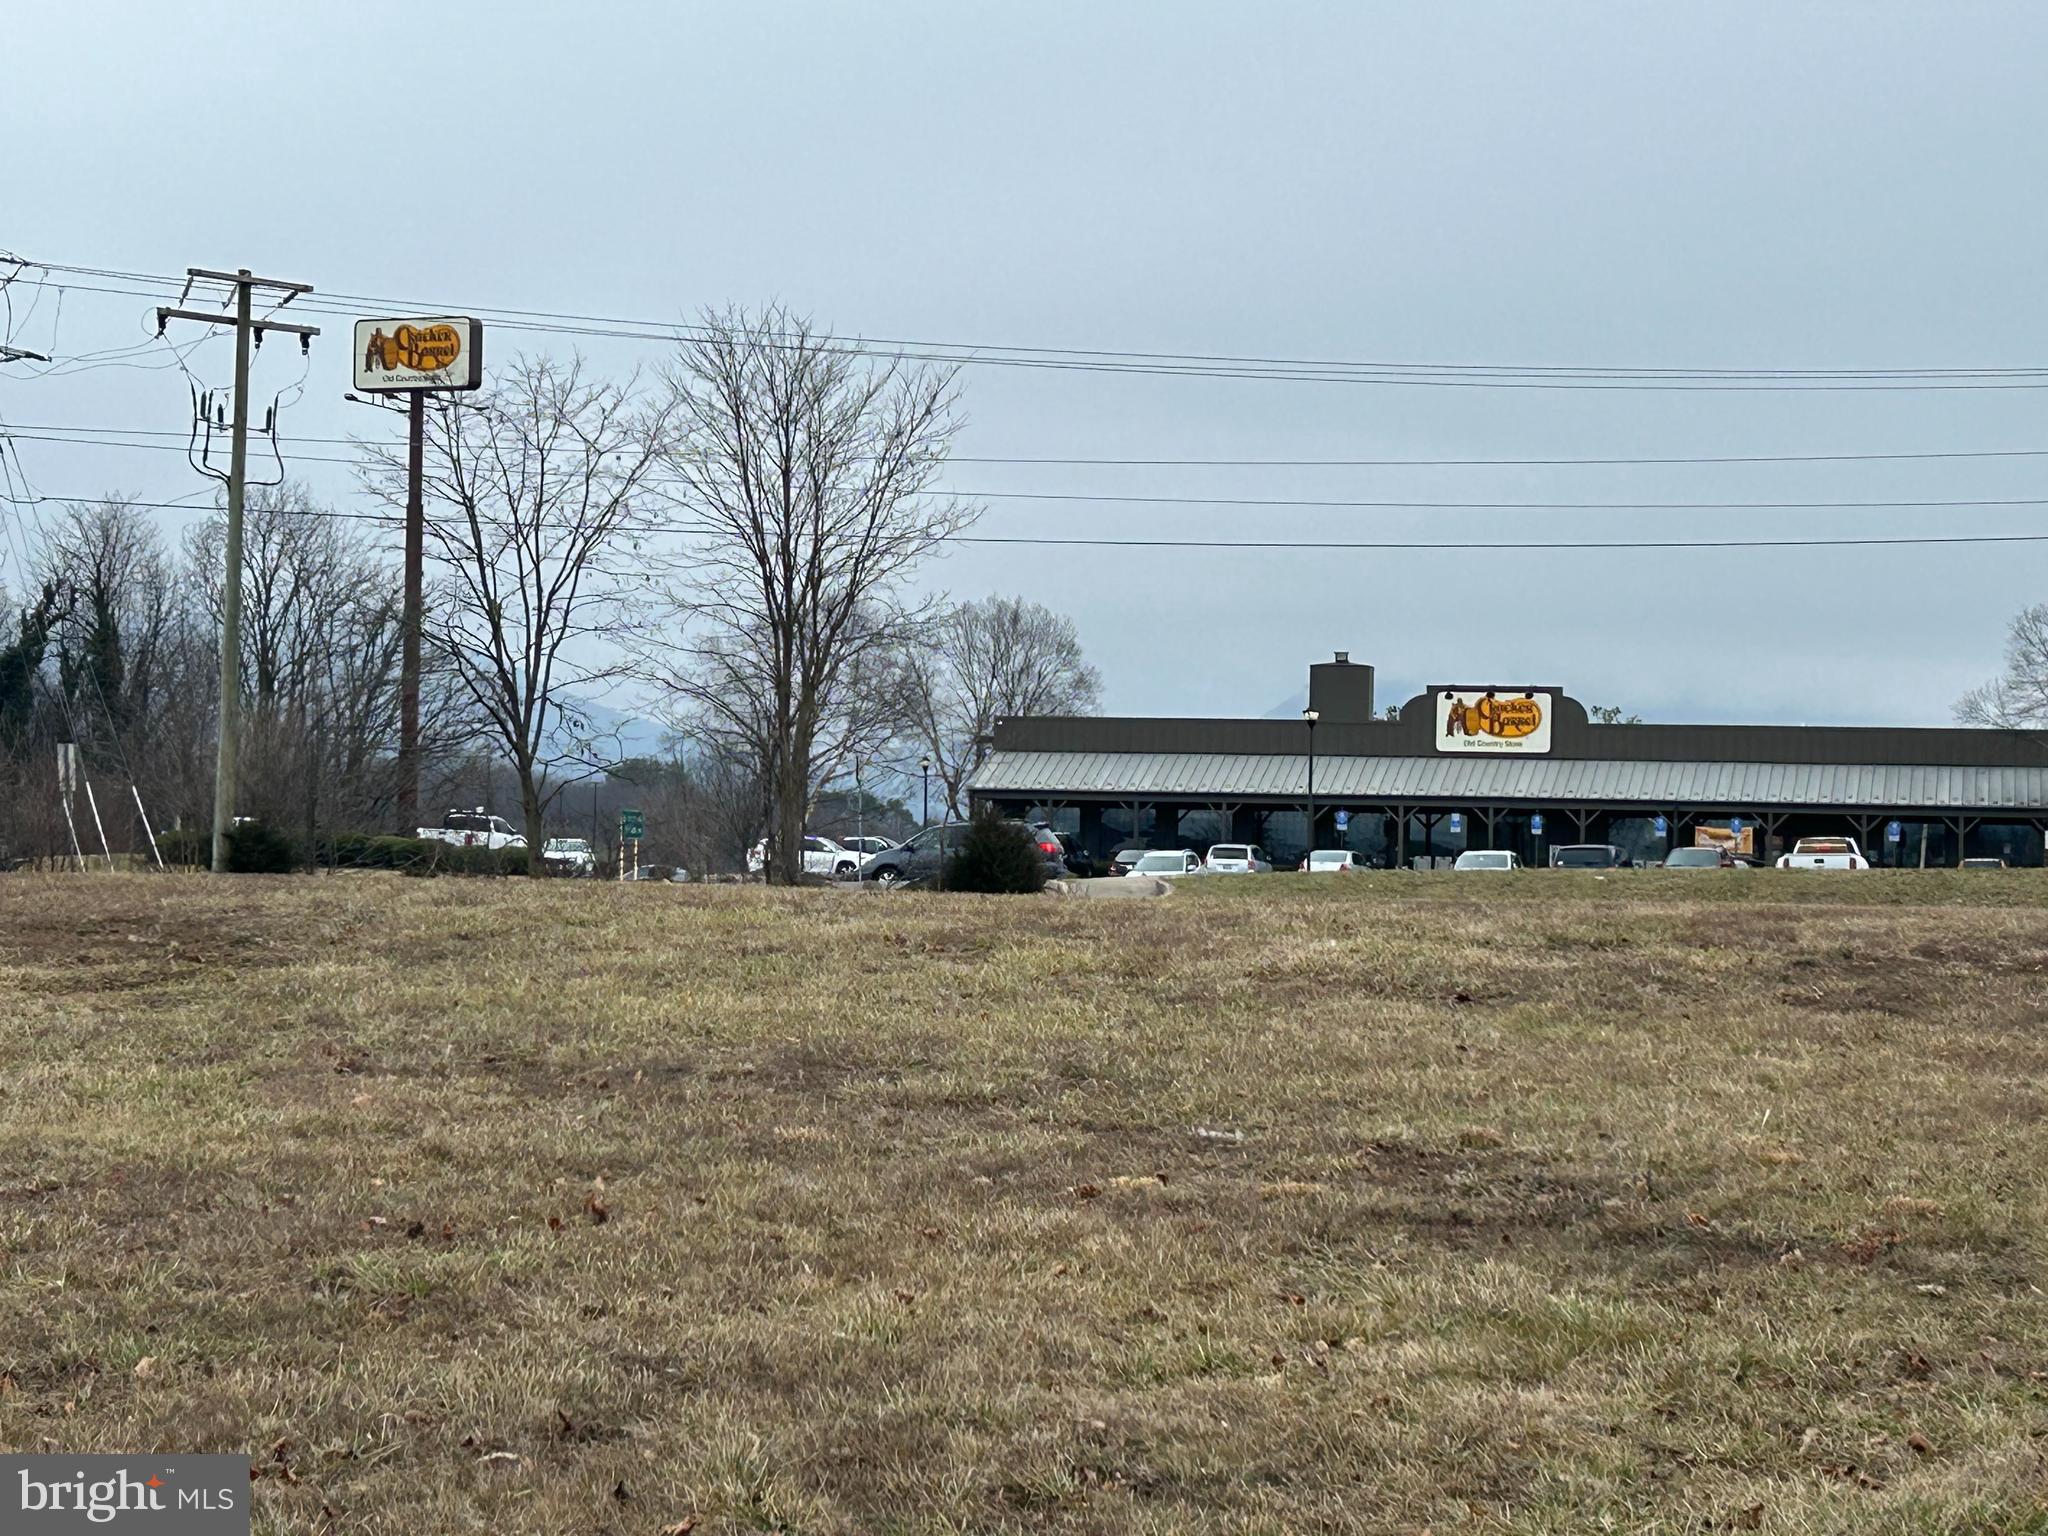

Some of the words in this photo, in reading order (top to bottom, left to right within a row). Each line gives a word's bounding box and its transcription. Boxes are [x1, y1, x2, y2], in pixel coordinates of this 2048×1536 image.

[1478, 698, 1533, 719] Cracker
[1489, 713, 1536, 736] Barrel
[1463, 739, 1476, 747] Old
[1477, 739, 1504, 749] Country
[1504, 739, 1523, 747] Store
